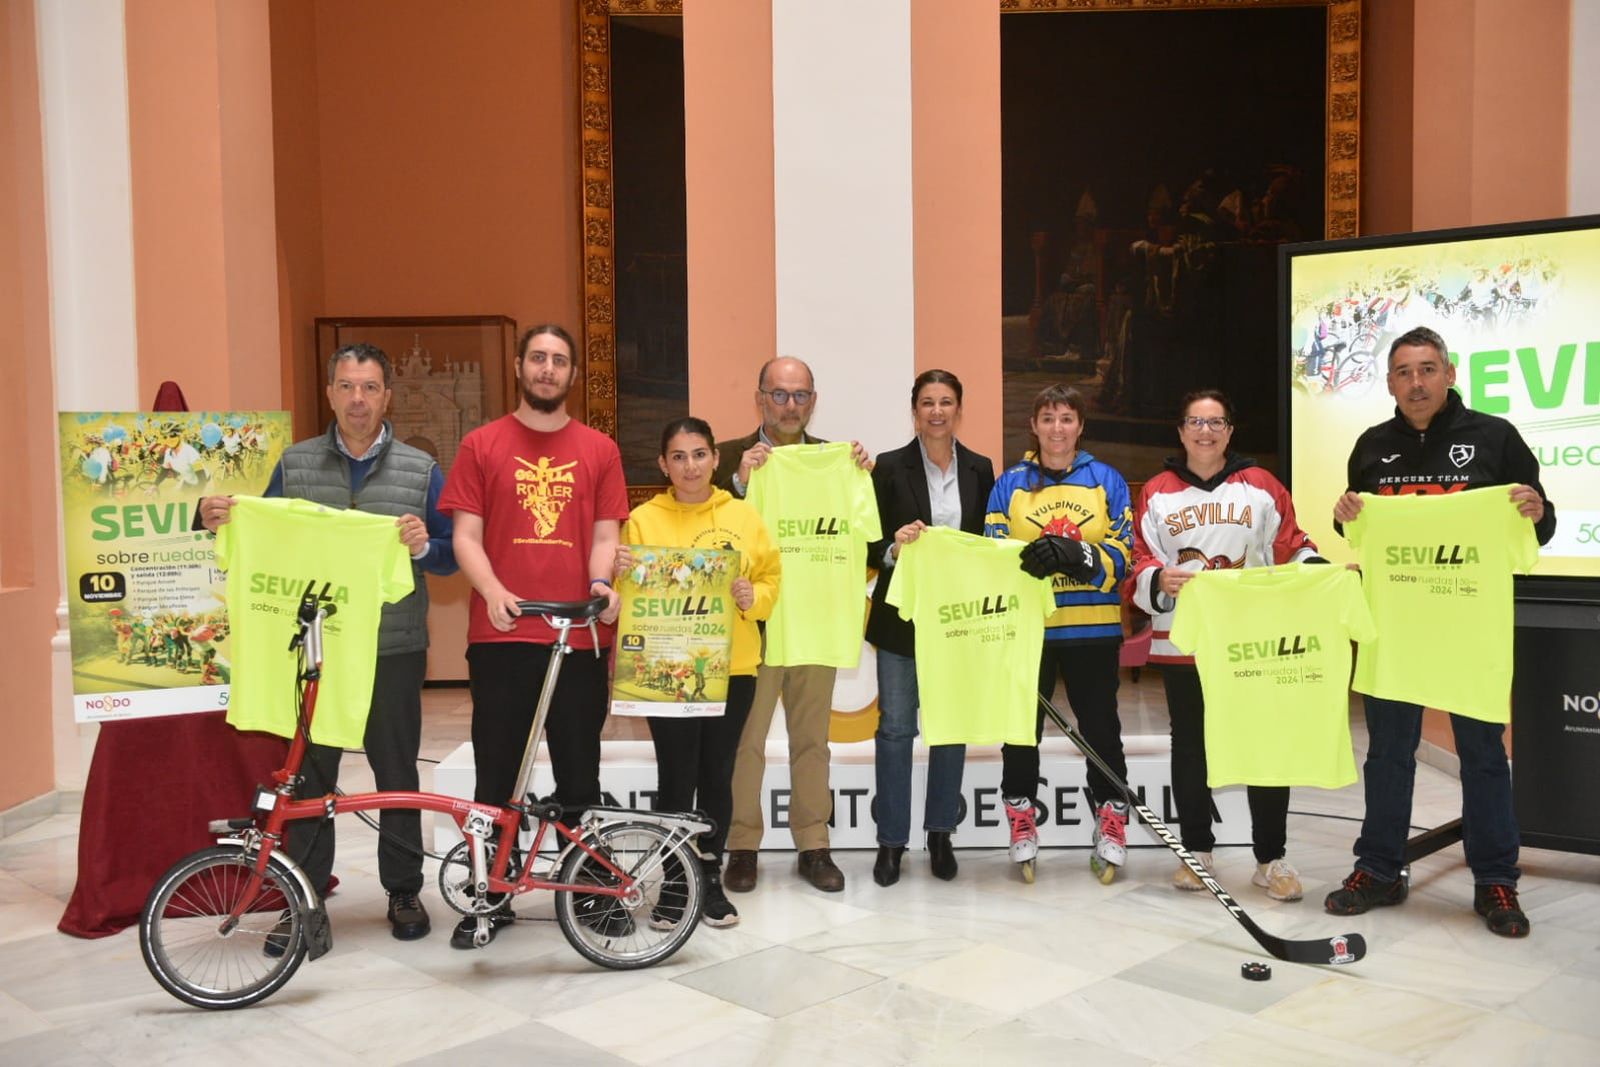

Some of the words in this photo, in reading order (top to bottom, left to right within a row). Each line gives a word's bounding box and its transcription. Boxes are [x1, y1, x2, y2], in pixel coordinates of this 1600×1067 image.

[1448, 341, 1600, 414] EVI
[1379, 475, 1433, 484] MERCURY
[516, 483, 573, 499] ROLLER
[523, 499, 567, 512] PRTY
[91, 502, 206, 541] SEVI
[777, 517, 850, 538] SEVILLA
[1164, 502, 1252, 537] SEVILLA
[97, 550, 149, 565] sobre
[153, 547, 216, 562] ruedas
[1385, 544, 1480, 566] SEVILLA
[90, 574, 116, 592] 10
[1389, 573, 1417, 583] sobre
[250, 572, 349, 604] SEVILLA
[1430, 585, 1452, 595] 2024
[251, 602, 279, 614] sobre
[632, 595, 724, 617] SEVILLA
[938, 594, 1020, 624] SEVILLA
[632, 623, 659, 632] sobre
[693, 622, 726, 635] 2024
[945, 629, 969, 638] sobre
[627, 636, 640, 646] 10
[1227, 635, 1322, 662] SEVILLA
[1233, 669, 1262, 678] sobre
[1276, 676, 1299, 685] 2024
[1562, 692, 1600, 718] NO
[1135, 805, 1243, 919] WINNWELL
